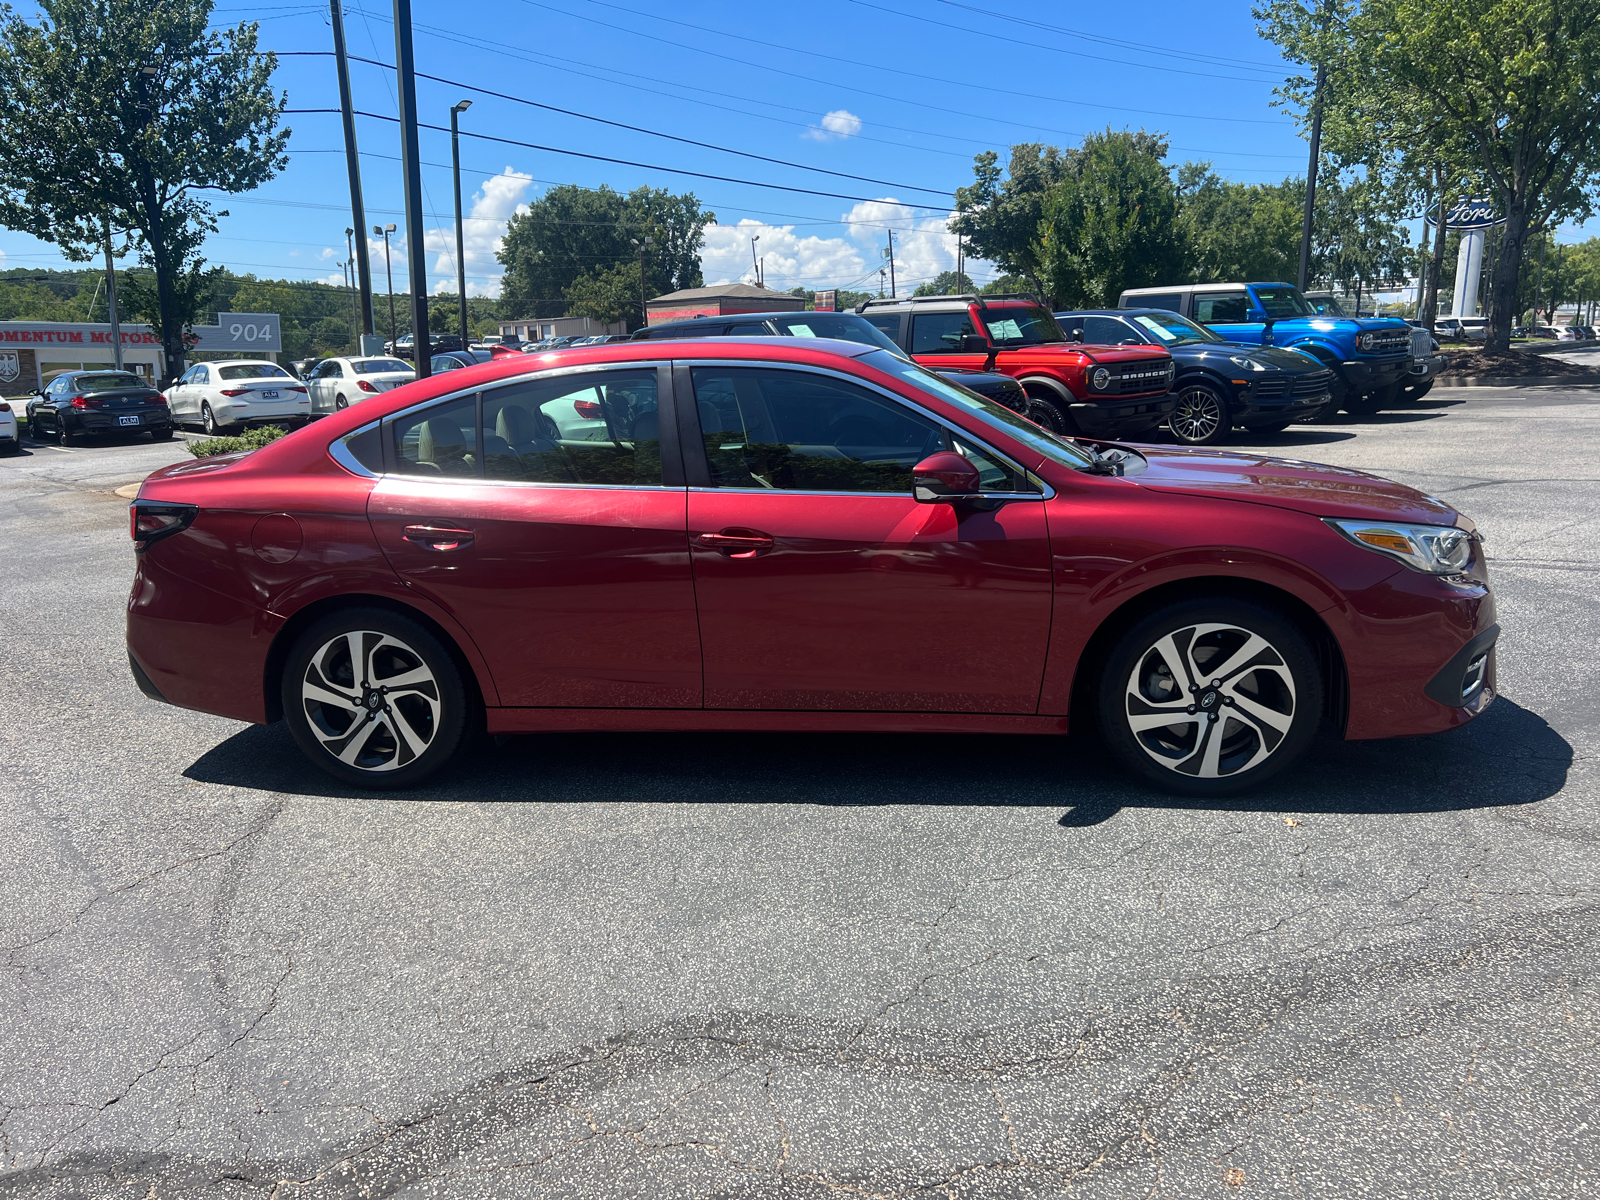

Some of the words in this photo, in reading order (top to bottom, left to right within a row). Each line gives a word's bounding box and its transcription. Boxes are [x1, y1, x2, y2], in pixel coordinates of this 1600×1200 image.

[0, 330, 83, 343] MENTUM
[229, 323, 272, 342] 904
[1122, 370, 1166, 380] BRONCO
[1286, 637, 1316, 700] YOKOHAMA
